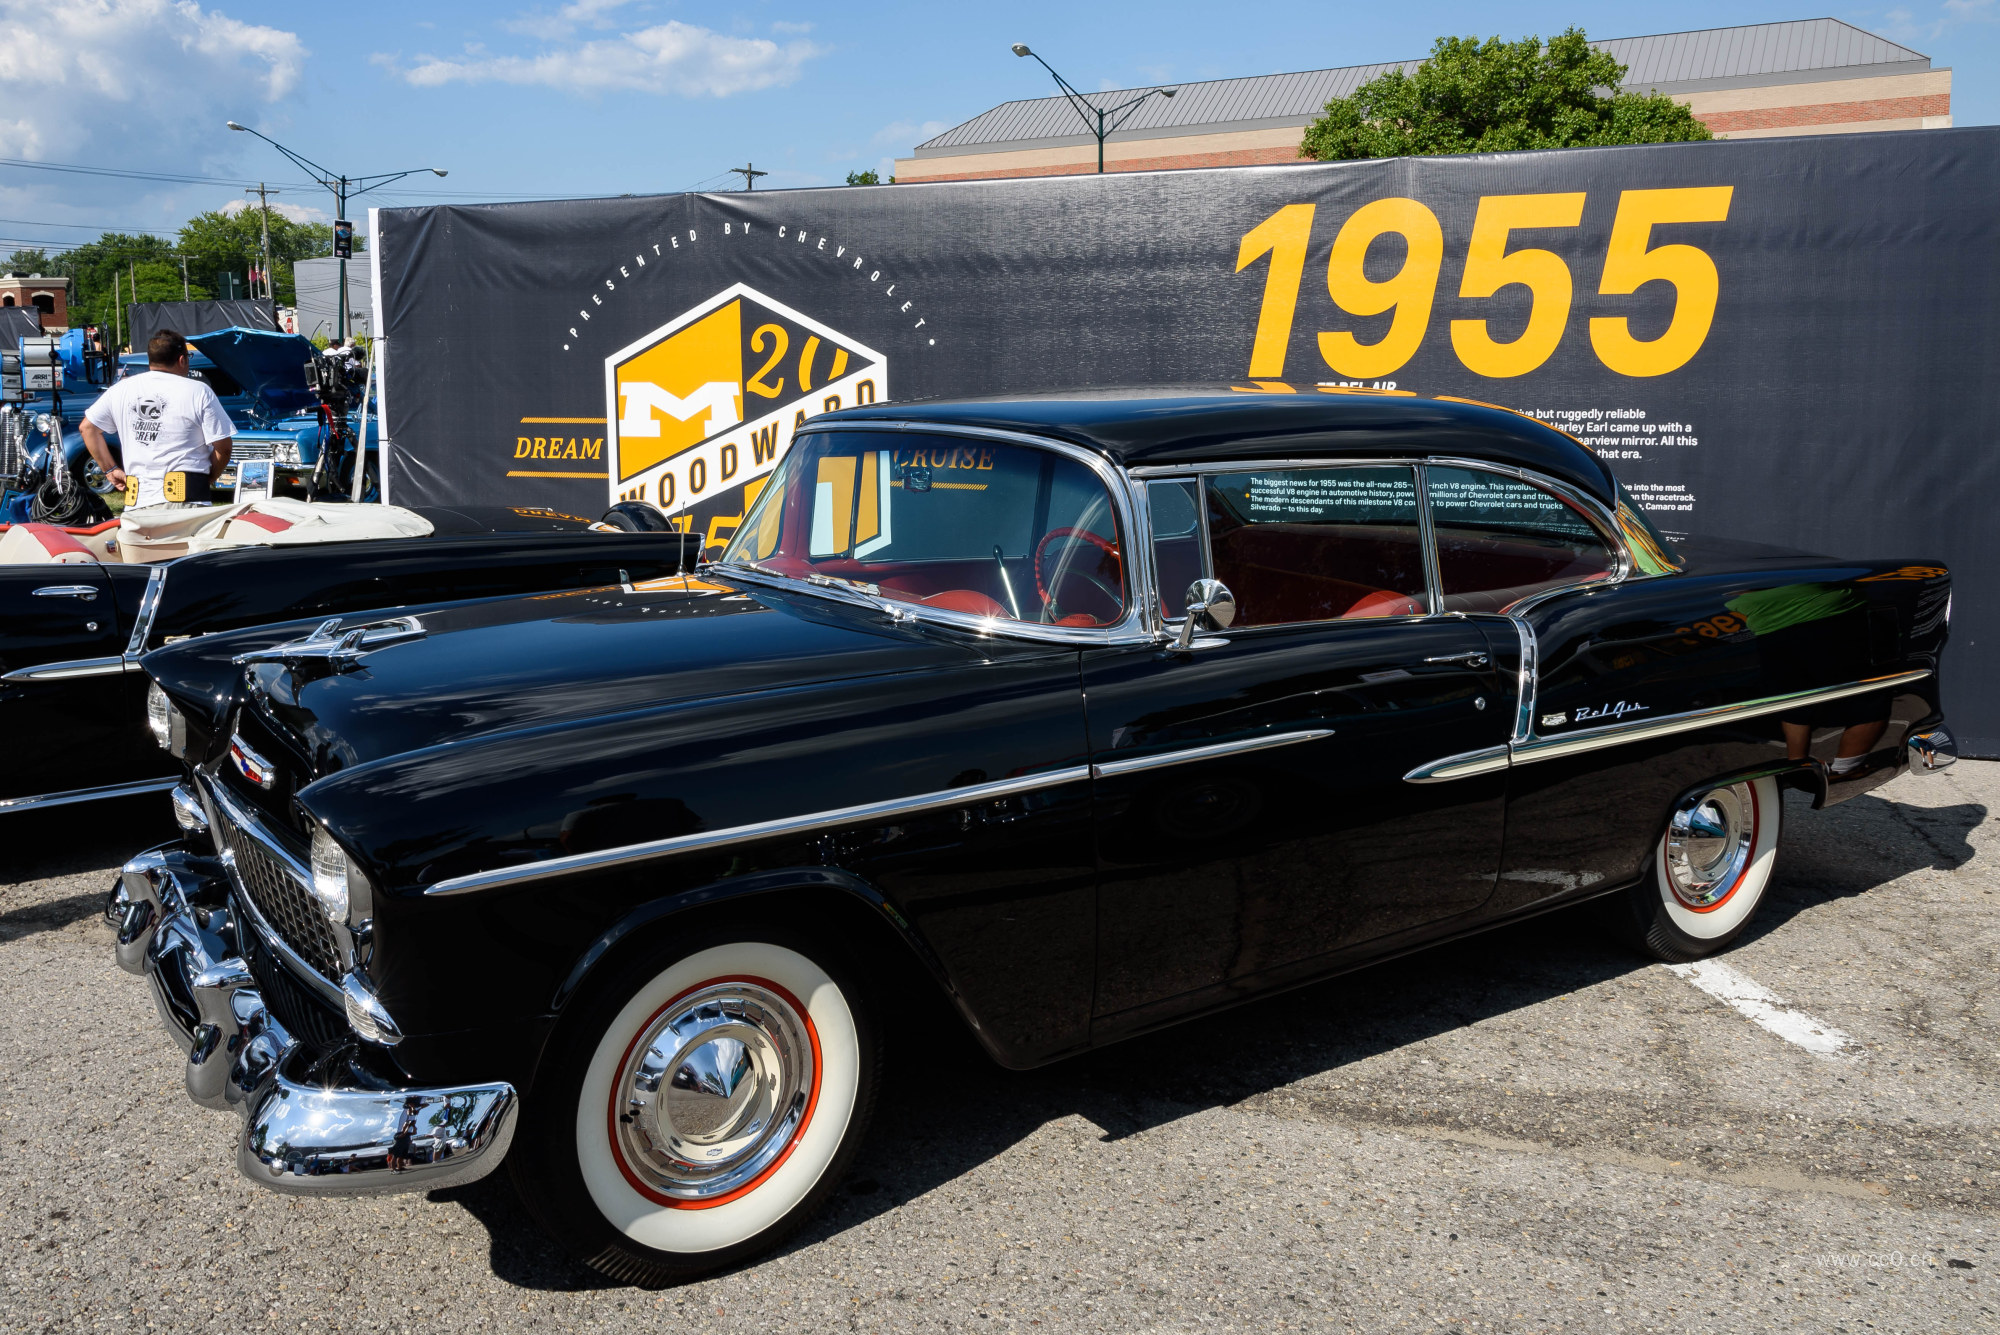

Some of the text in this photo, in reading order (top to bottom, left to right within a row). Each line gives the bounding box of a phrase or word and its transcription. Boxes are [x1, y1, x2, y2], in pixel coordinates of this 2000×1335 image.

[569, 222, 926, 338] PRESENTED BY CHEVROLET
[1235, 185, 1735, 377] 1955
[1536, 409, 1554, 419] but
[1557, 409, 1603, 421] ruggedly
[1606, 409, 1646, 419] reliable
[134, 421, 162, 431] CRUISE
[1587, 423, 1608, 432] Earl
[1610, 424, 1638, 432] came
[1642, 425, 1656, 434] up
[1659, 422, 1682, 432] with
[135, 432, 159, 441] CREW
[1622, 436, 1658, 446] mirror.
[1660, 436, 1674, 446] All
[1677, 436, 1698, 446] this
[513, 437, 996, 470] DREAM CRUISE
[1597, 450, 1642, 459] that era.
[1264, 478, 1288, 488] biggest
[1353, 480, 1365, 488] the
[1461, 483, 1487, 492] engine.
[1297, 489, 1320, 497] engine
[1369, 489, 1395, 498] history,
[1310, 506, 1324, 514] day.
